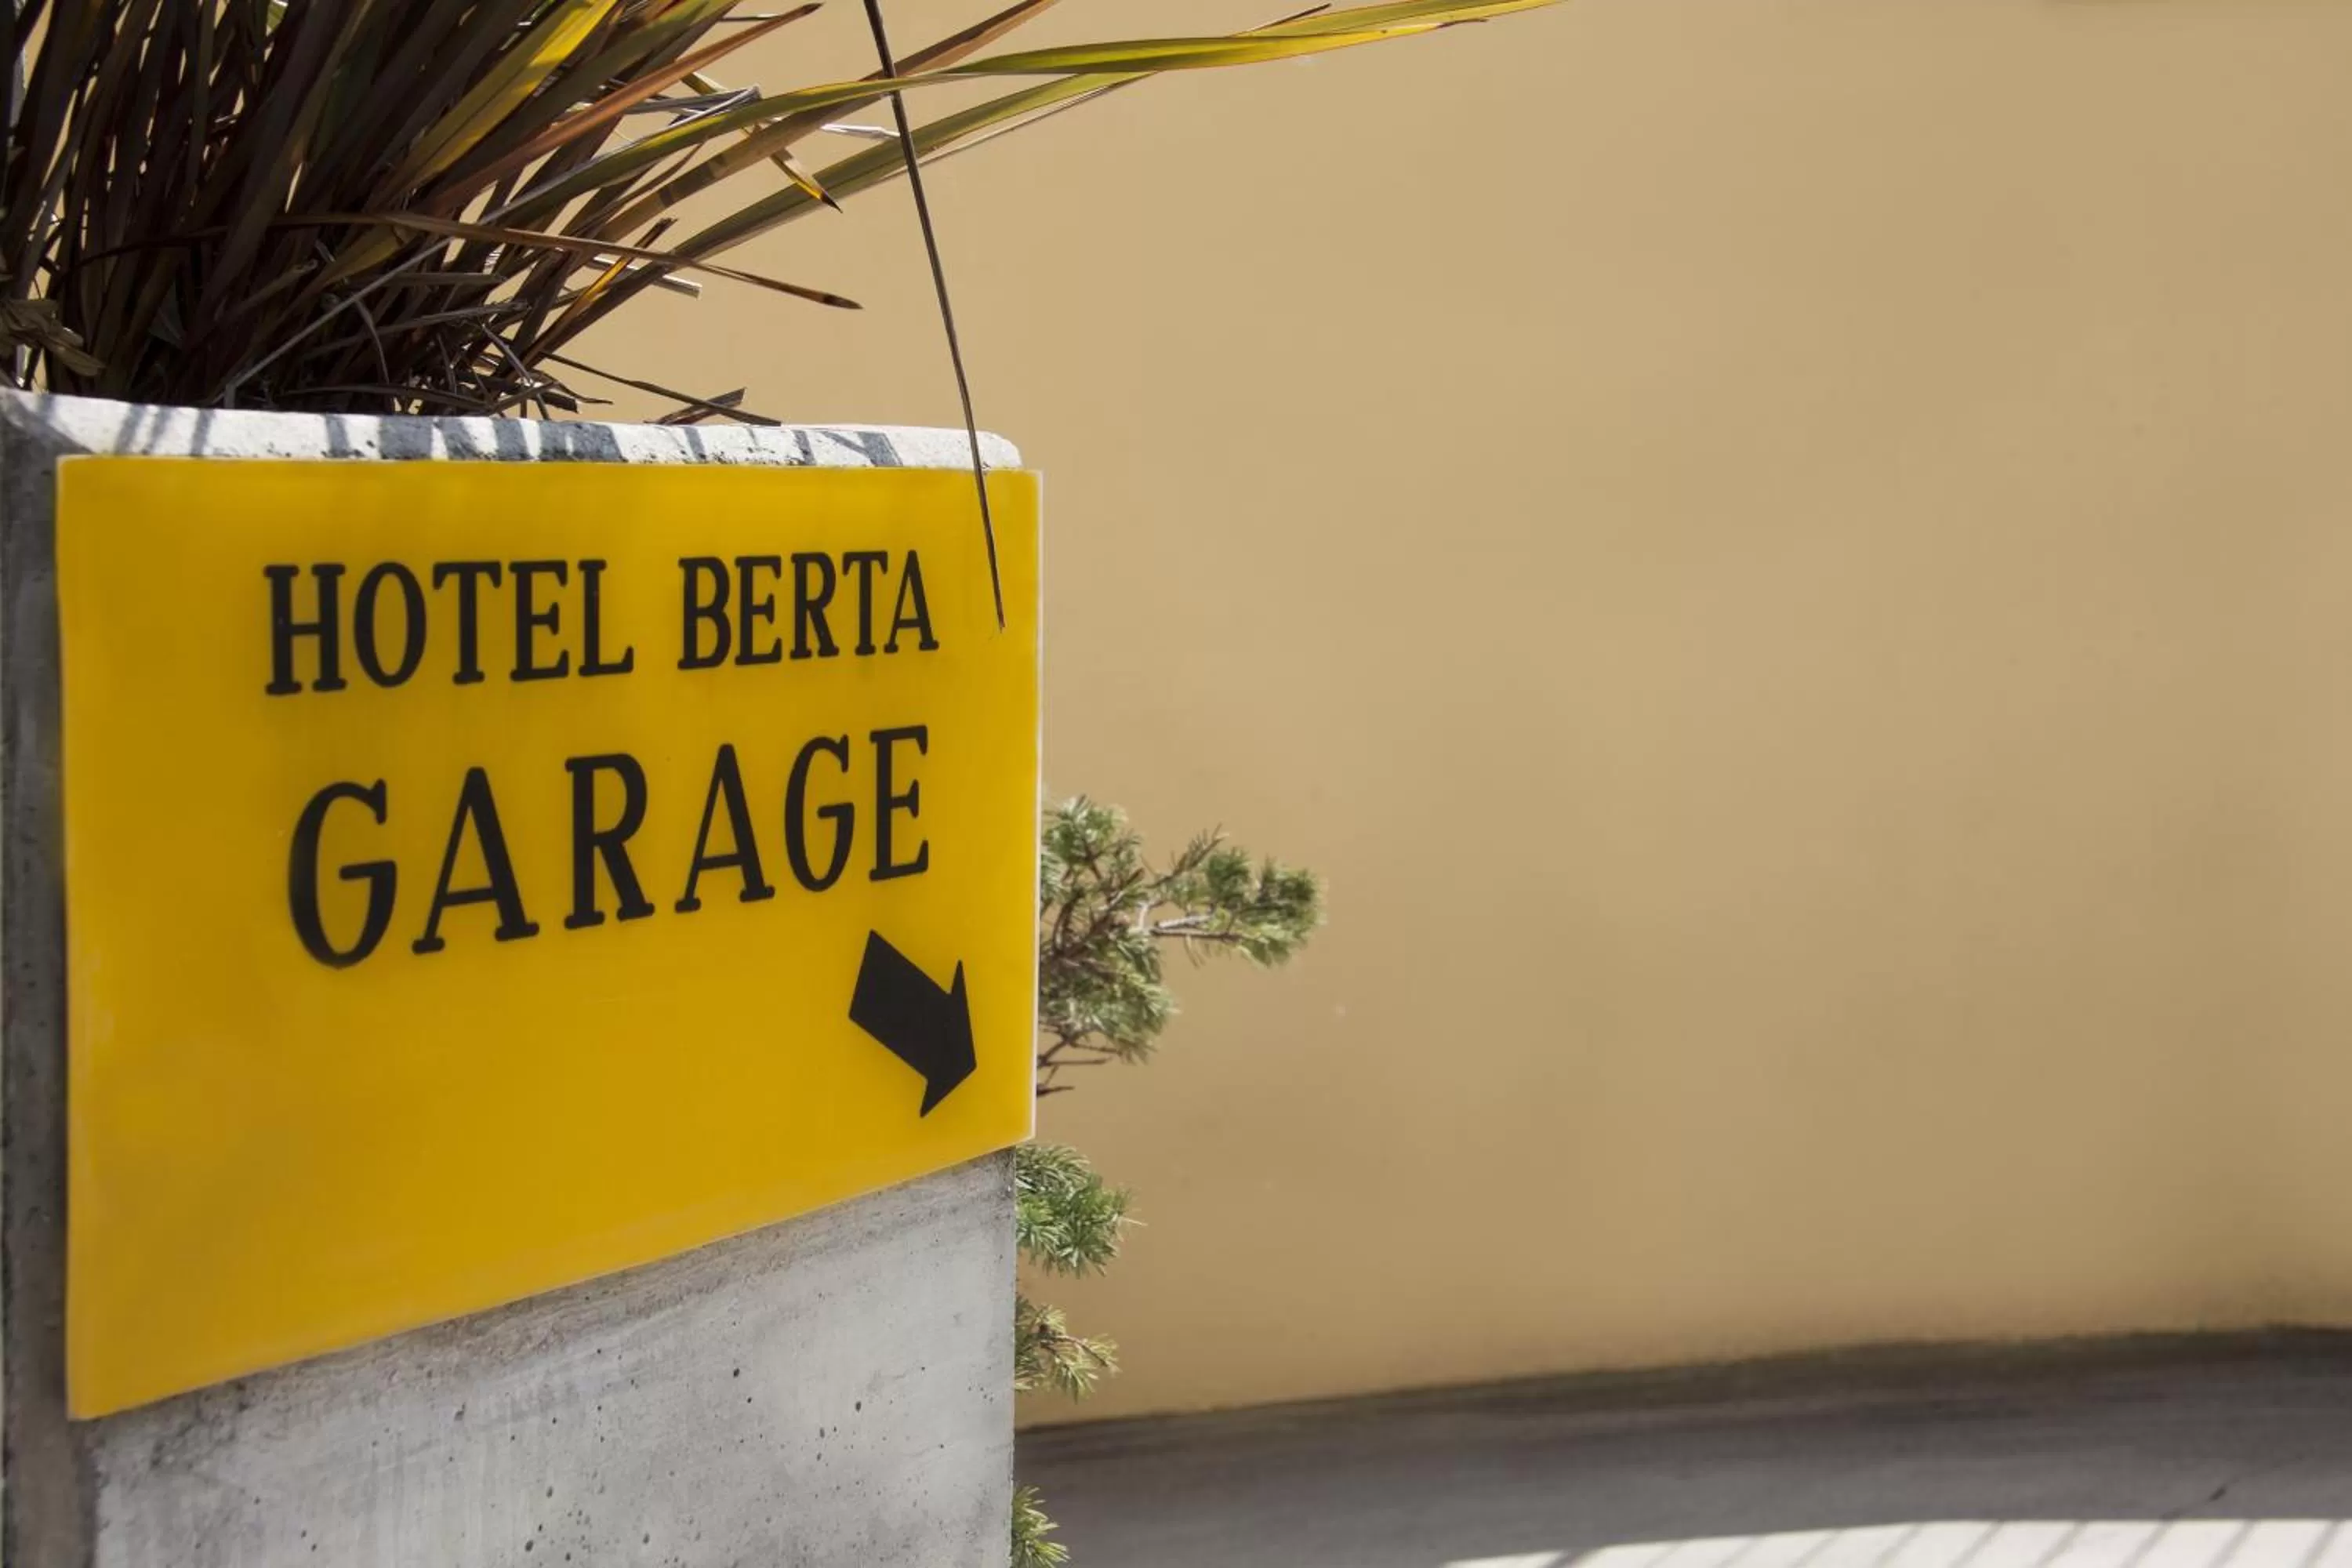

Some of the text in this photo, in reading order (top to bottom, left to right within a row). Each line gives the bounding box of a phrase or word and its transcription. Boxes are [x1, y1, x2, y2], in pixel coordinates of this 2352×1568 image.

[263, 548, 940, 697] HOTEL BERTA
[286, 724, 931, 970] GARAGE
